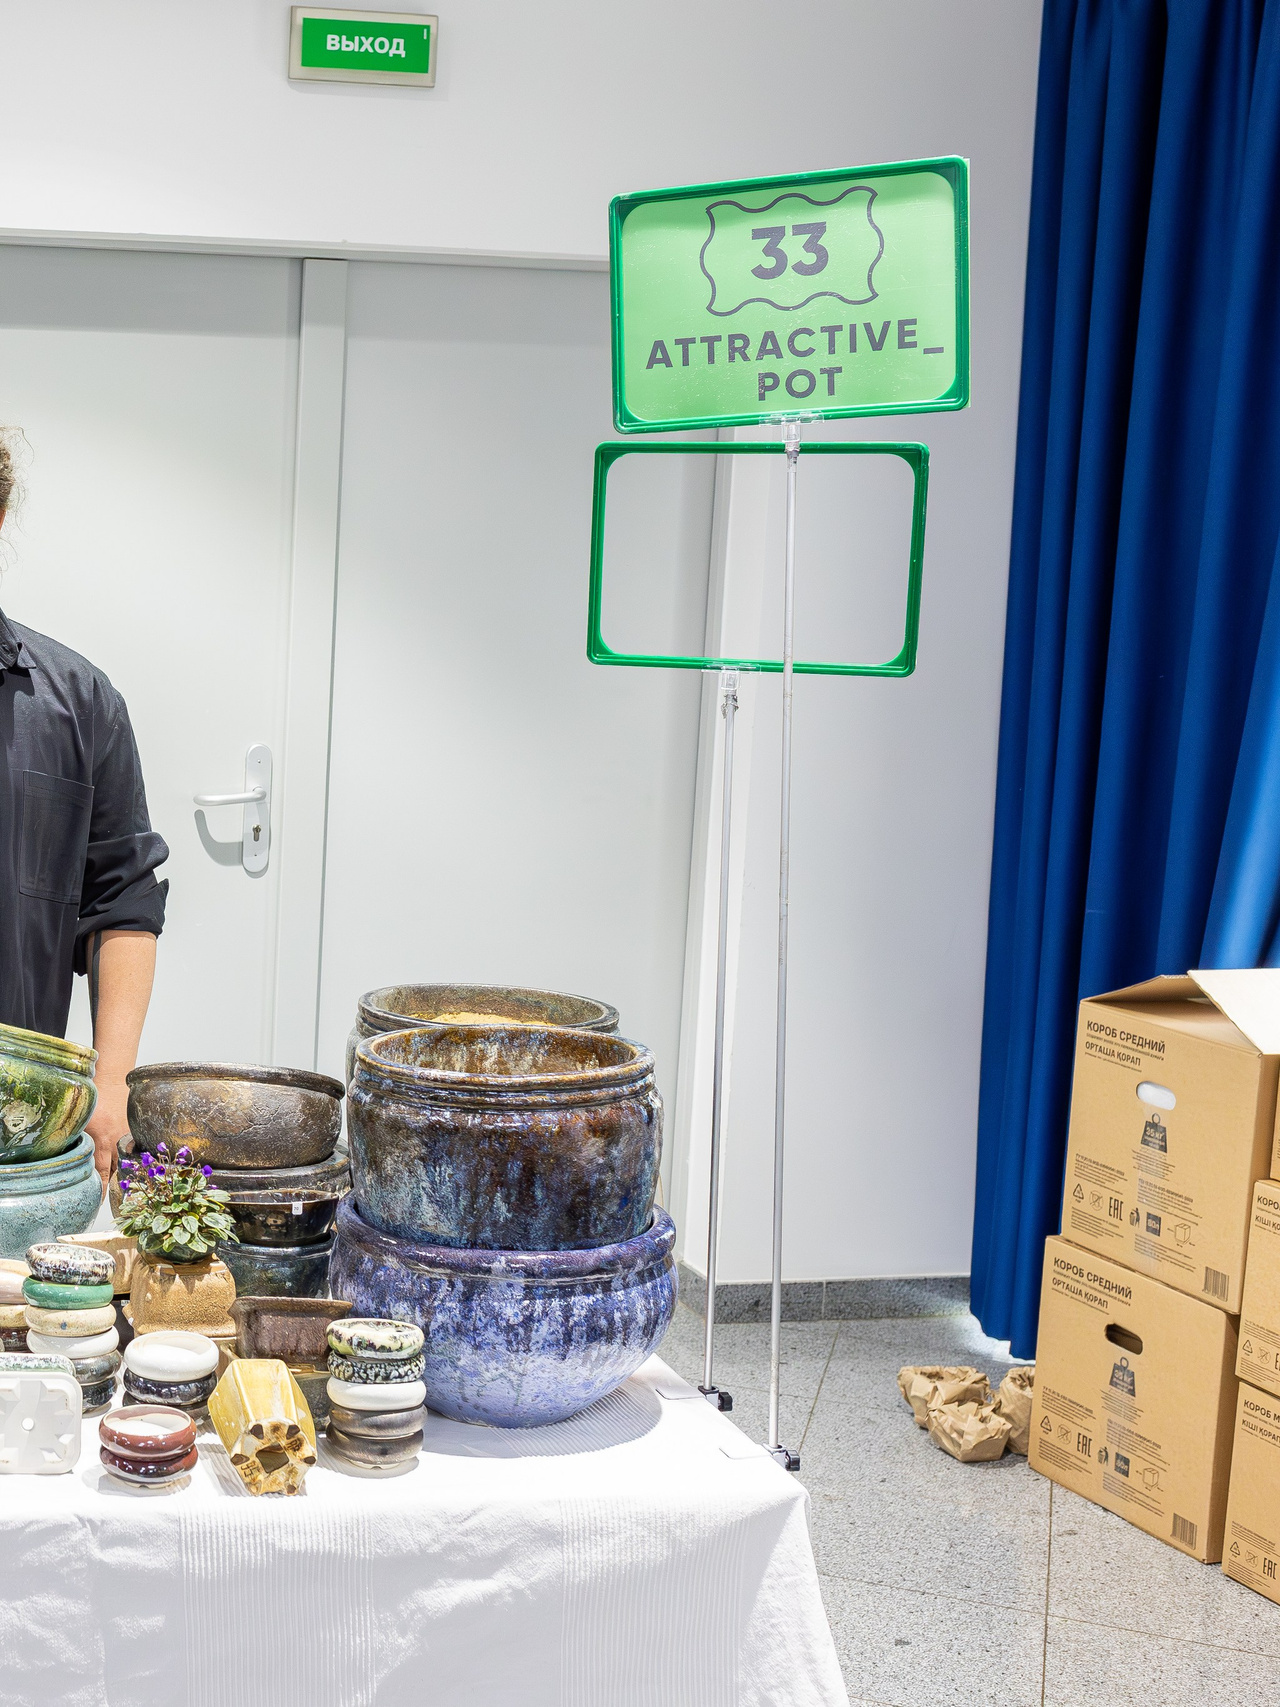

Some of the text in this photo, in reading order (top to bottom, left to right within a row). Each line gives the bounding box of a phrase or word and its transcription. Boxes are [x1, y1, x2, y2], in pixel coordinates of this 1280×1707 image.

[326, 34, 406, 58] ВЫХОД
[750, 221, 829, 280] 33
[646, 318, 945, 370] ATTRACTIVE_
[758, 366, 843, 402] POT
[1085, 1041, 1116, 1058] ОРТАША
[1086, 1020, 1118, 1038] КОРОБ
[1119, 1031, 1166, 1054] СРЕДНИЙ
[1257, 1195, 1280, 1210] КОРО
[1052, 1277, 1083, 1298] ОРТАША
[1053, 1256, 1085, 1278] КОРОБ
[1086, 1271, 1132, 1300] СРЕДНИЙ
[1243, 1399, 1272, 1419] КОРОБ
